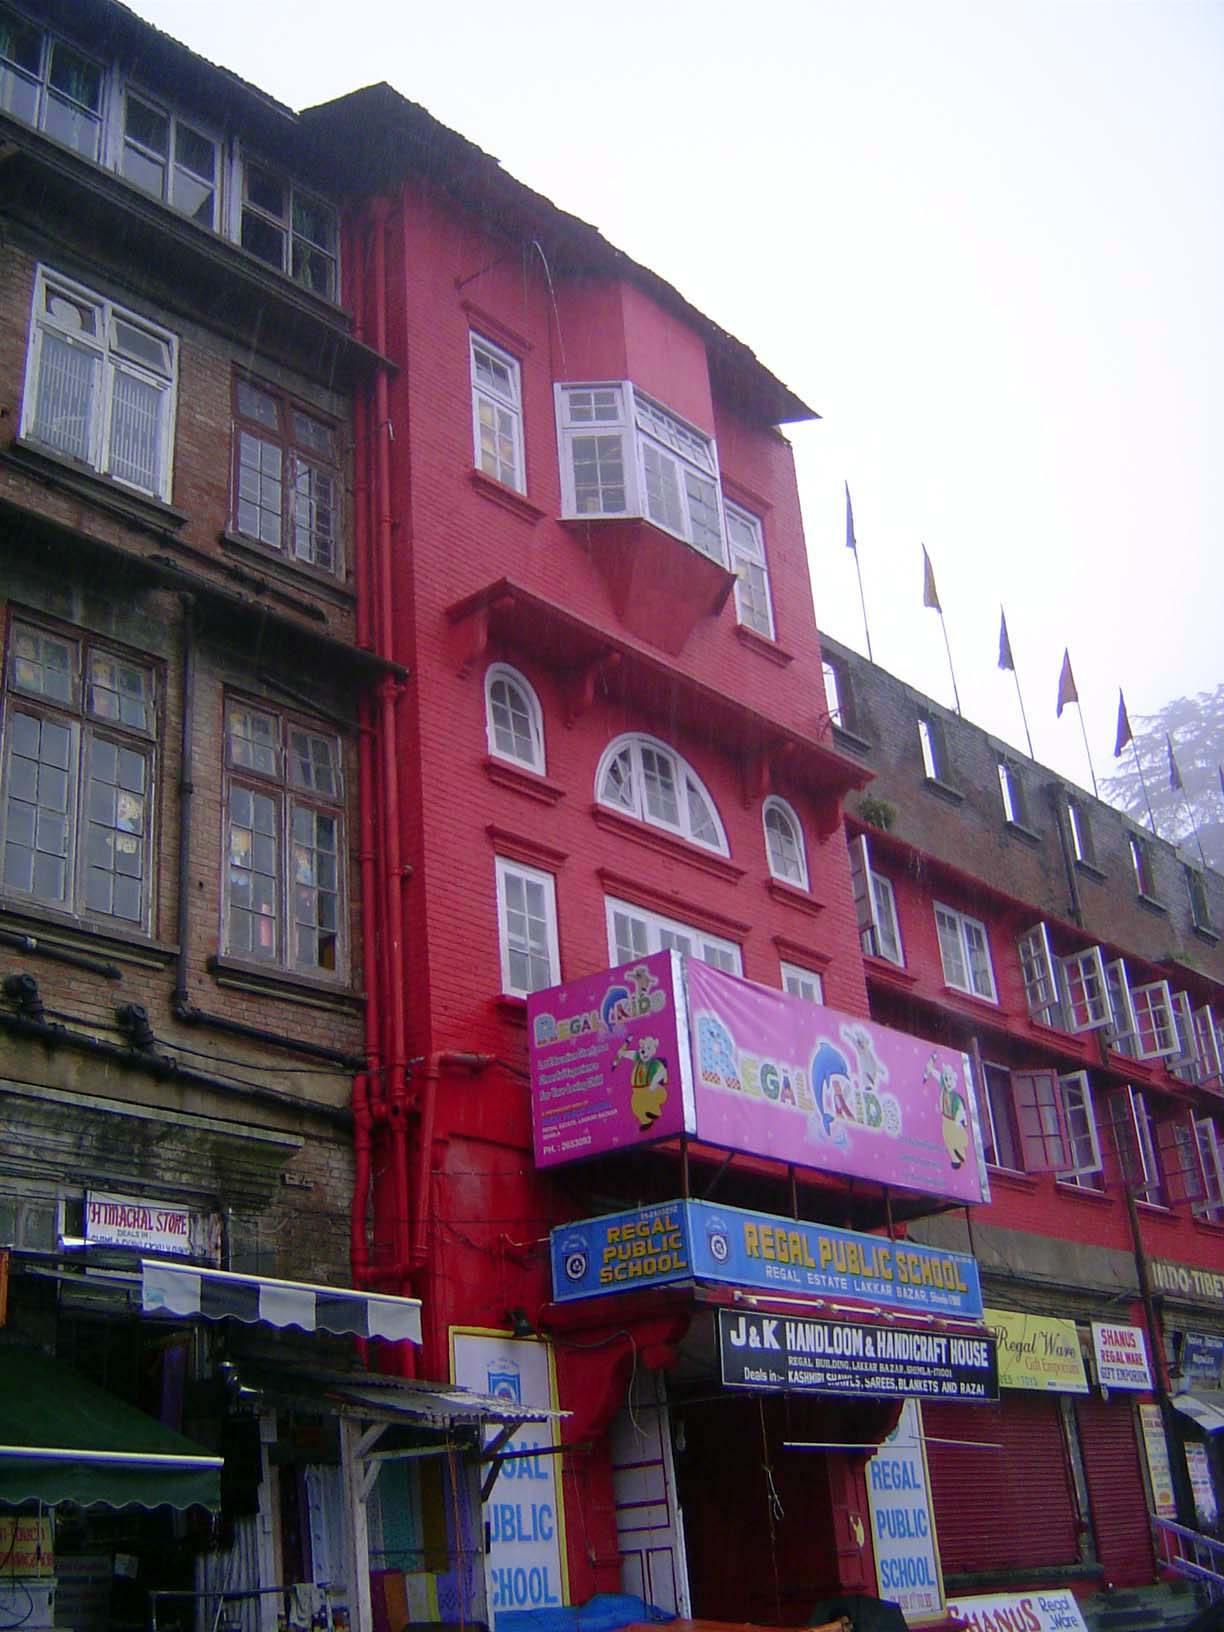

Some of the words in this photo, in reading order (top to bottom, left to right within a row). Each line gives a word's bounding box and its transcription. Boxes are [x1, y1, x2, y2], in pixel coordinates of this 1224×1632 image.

[535, 1010, 606, 1047] REGAL
[699, 1015, 817, 1114] REGAL
[91, 1202, 154, 1231] HIMACHAL
[156, 1211, 187, 1235] STORE
[607, 1216, 680, 1244] REGAL
[603, 1233, 683, 1264] PUBLIC
[744, 1222, 816, 1268] REGAL
[818, 1235, 893, 1281] PUBLIC
[896, 1251, 968, 1292] SCHOOL
[600, 1252, 688, 1285] SCHOOL
[766, 1265, 801, 1283] REGAL
[807, 1272, 848, 1290] ESTATE
[853, 1279, 893, 1297] LAKKAR
[785, 1321, 863, 1357] HANDLOOM
[865, 1335, 876, 1358] &
[877, 1330, 948, 1364] HANDICRAFT
[950, 1338, 989, 1367] HOUSE
[992, 1325, 1038, 1361] Regal
[1040, 1330, 1077, 1359] Ware
[1101, 1327, 1137, 1349] SHANUS
[788, 1356, 813, 1368] REGAL
[852, 1361, 878, 1372] LAKKAR
[1100, 1349, 1125, 1365] REGAL
[1125, 1351, 1144, 1366] WARE
[1100, 1367, 1116, 1380] GIFT
[744, 1366, 768, 1381] Deals
[788, 1370, 825, 1384] KASHMIRI
[898, 1378, 939, 1393] BLANKETS
[942, 1381, 957, 1393] AND
[870, 1459, 922, 1491] REGAL
[876, 1508, 929, 1540] PUBLIC
[880, 1556, 935, 1589] SCHOOL
[1039, 1596, 1071, 1612] Regal
